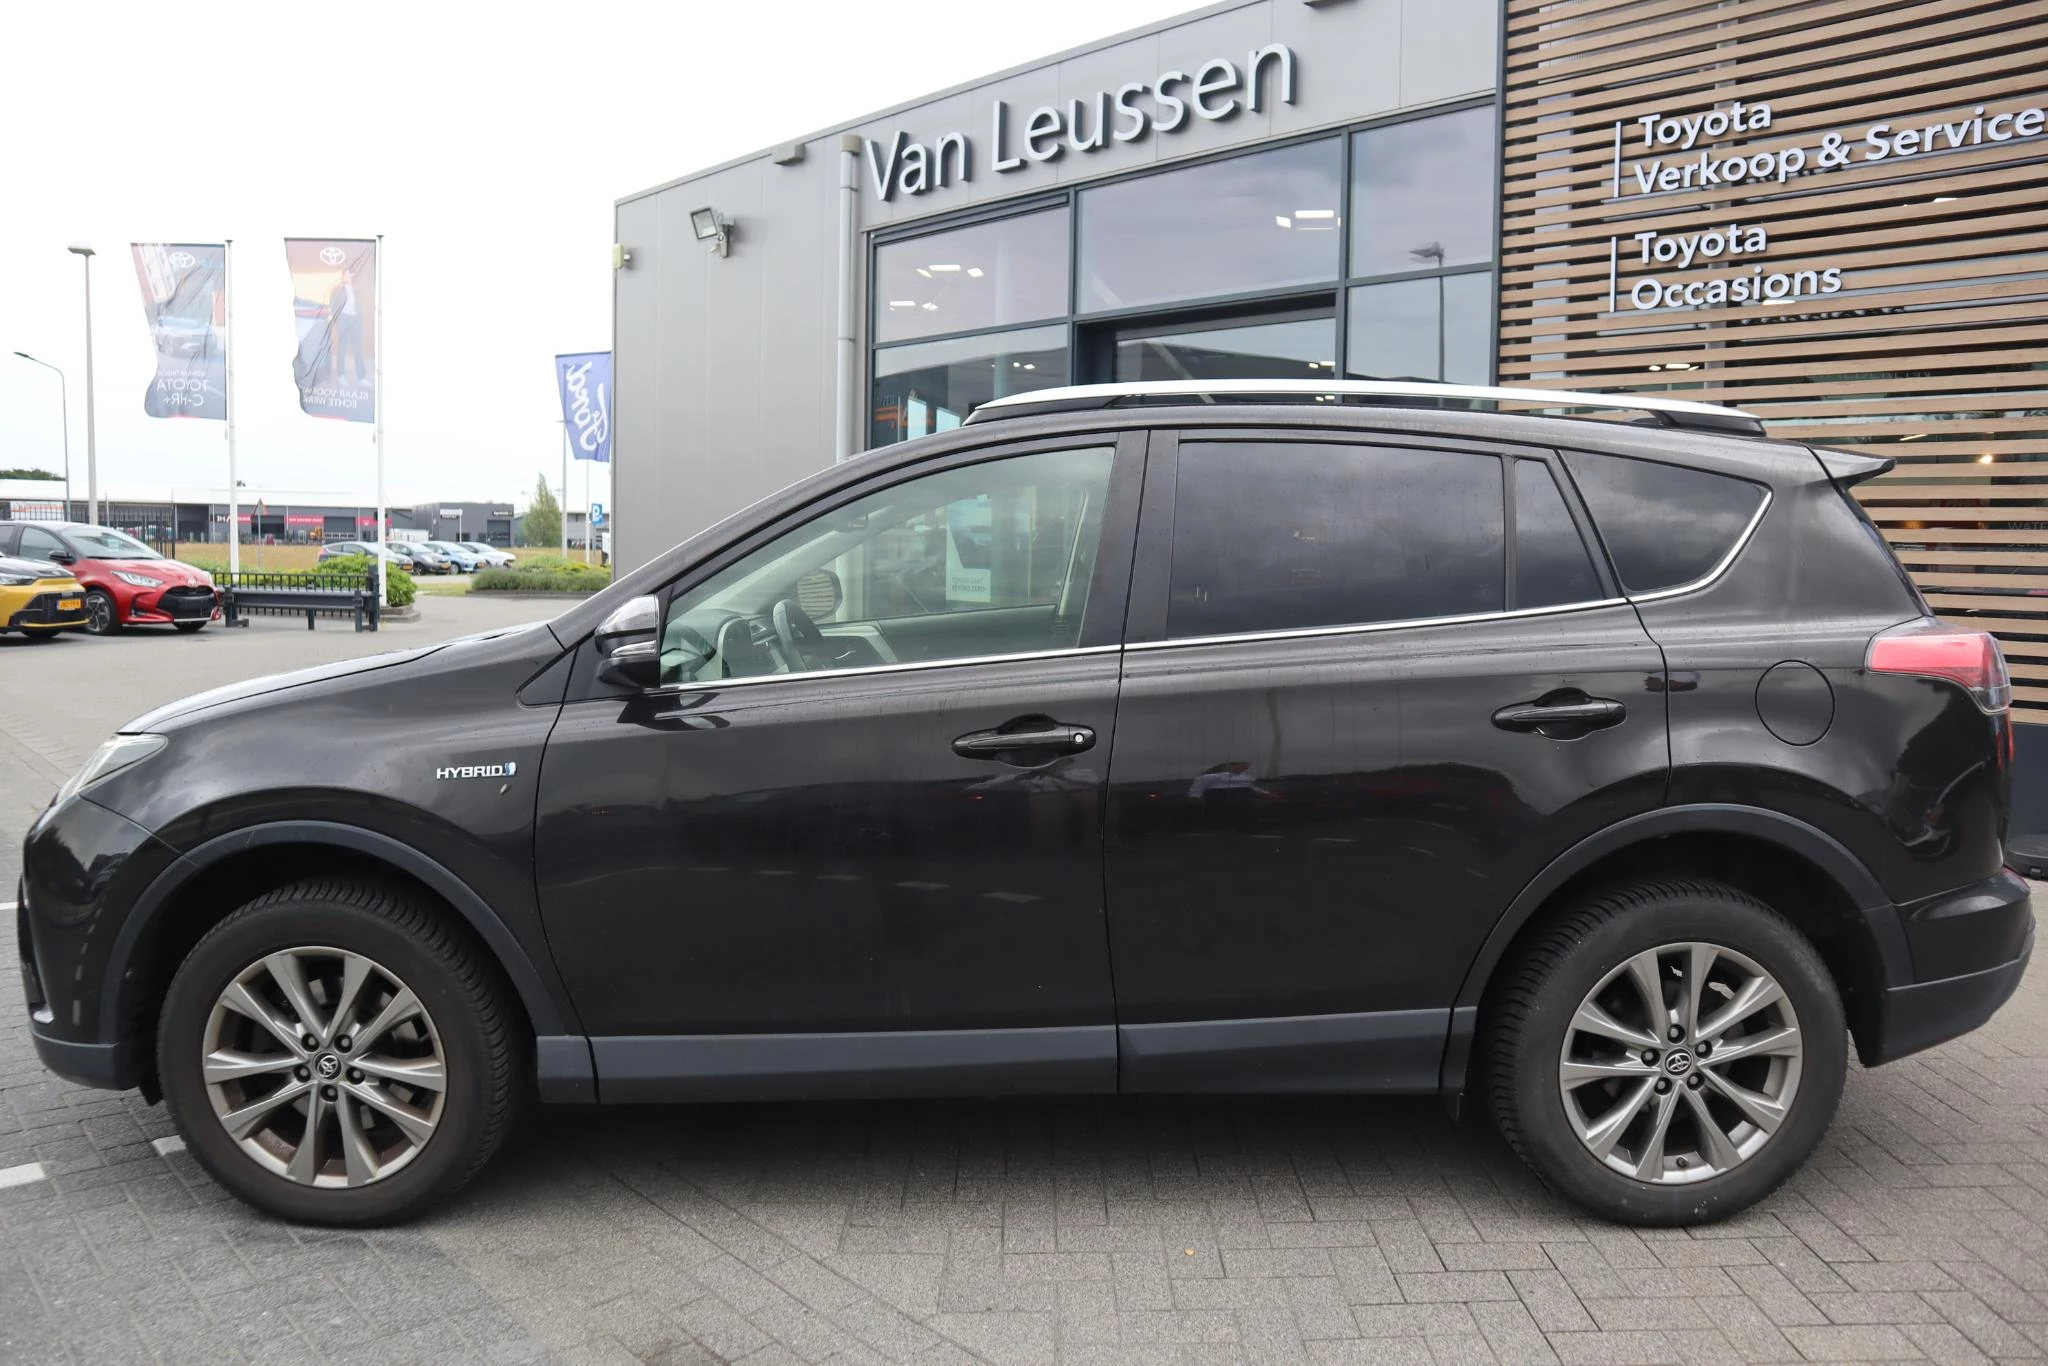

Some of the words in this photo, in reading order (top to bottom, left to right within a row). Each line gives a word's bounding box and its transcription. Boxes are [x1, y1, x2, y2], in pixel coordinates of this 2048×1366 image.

[865, 130, 972, 201] Van
[991, 42, 1297, 173] Leussen
[1638, 101, 1772, 150] Toyota
[1634, 142, 1806, 194] Verkoop
[1817, 132, 1851, 168] &
[1864, 106, 2047, 161] Service
[1634, 223, 1768, 269] Toyota
[1630, 266, 1843, 311] Occasions
[436, 765, 503, 779] HYBRID
